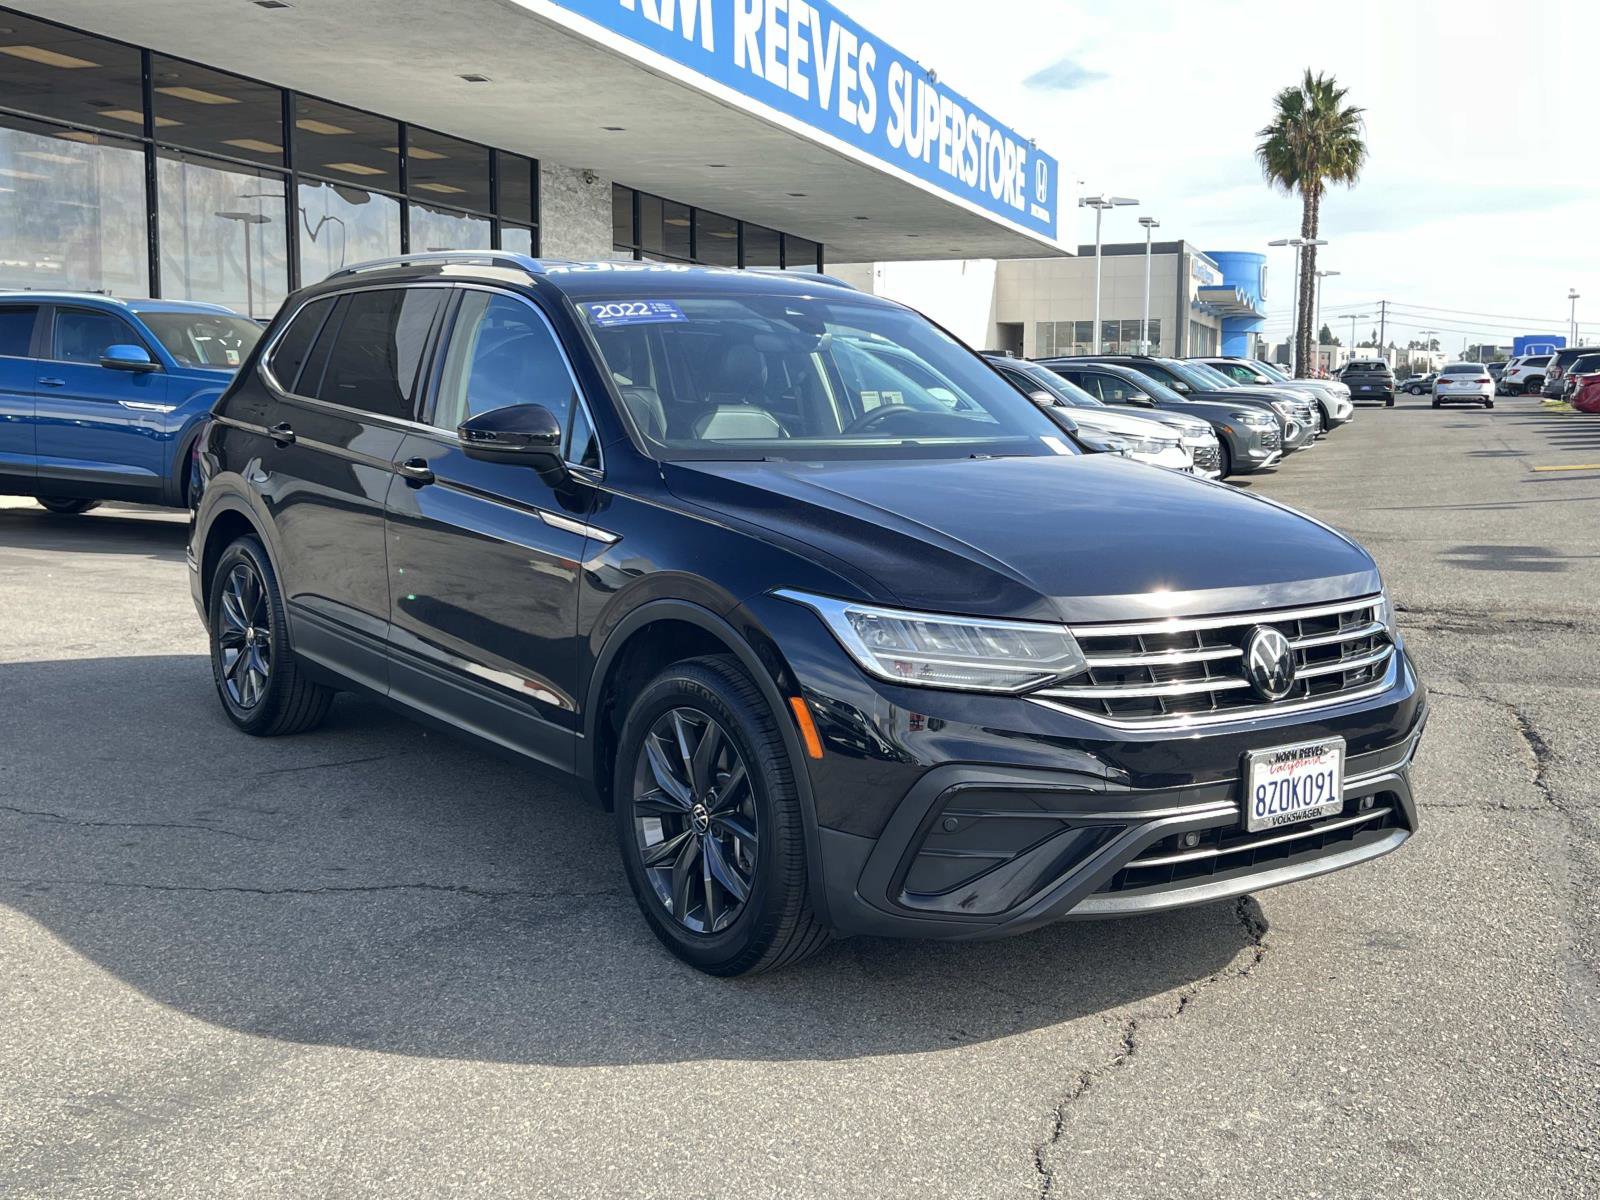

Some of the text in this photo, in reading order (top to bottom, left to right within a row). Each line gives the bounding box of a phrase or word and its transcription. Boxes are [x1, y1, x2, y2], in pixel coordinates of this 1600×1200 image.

[733, 0, 1027, 212] REEVES SUPERSTORE
[591, 302, 653, 318] 2022
[1271, 807, 1324, 826] VOLKSWAGEN
